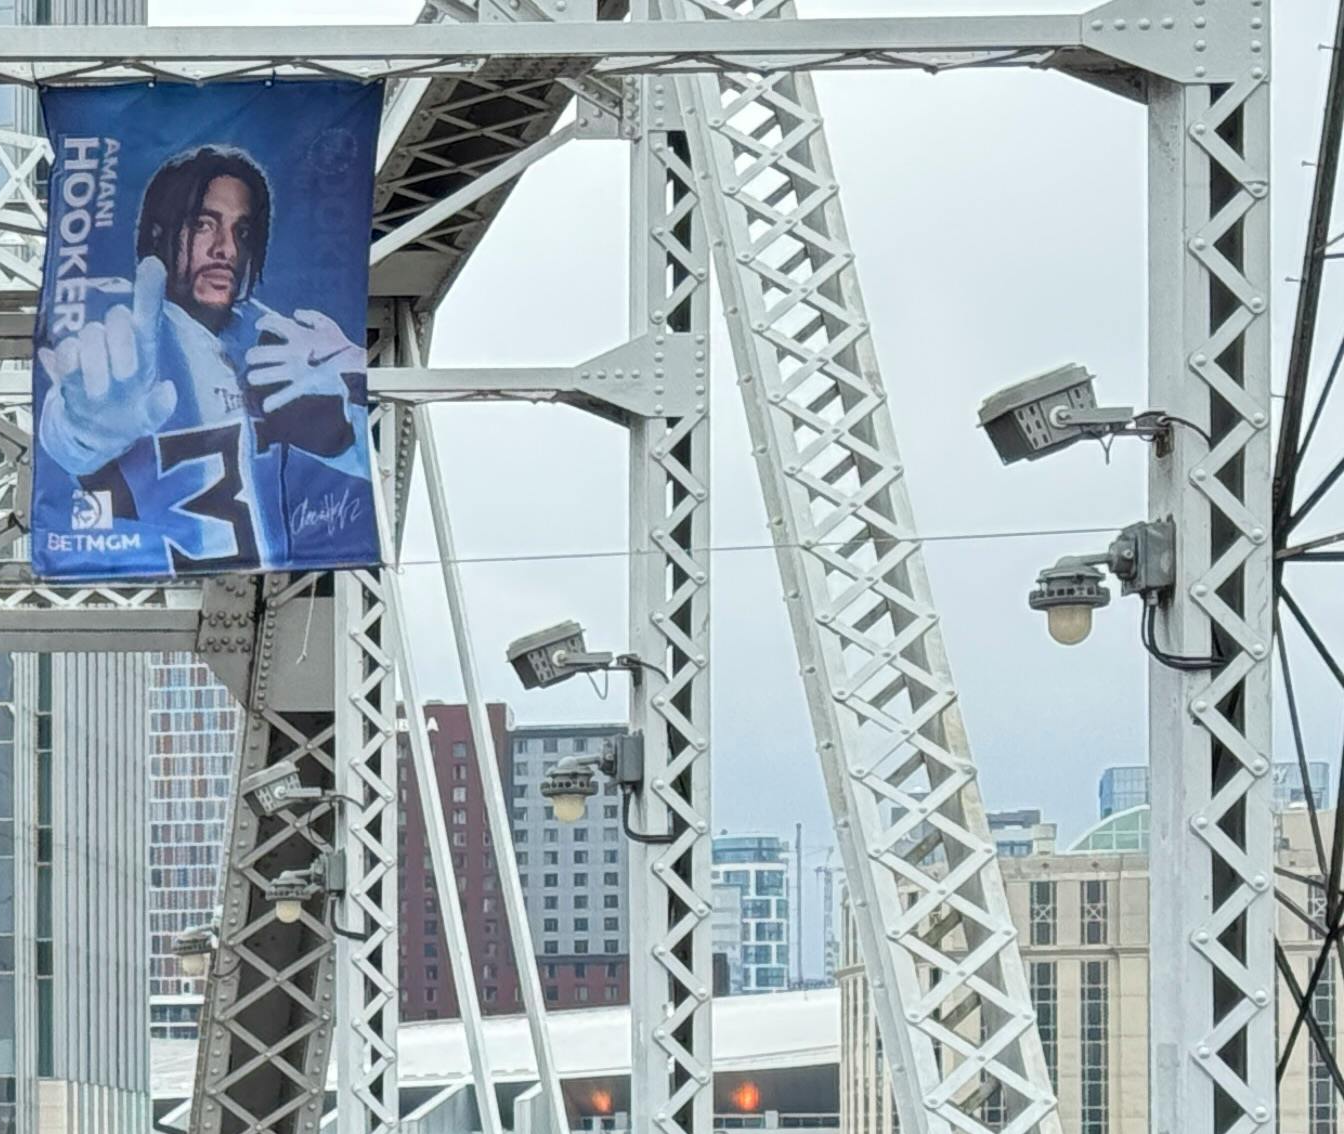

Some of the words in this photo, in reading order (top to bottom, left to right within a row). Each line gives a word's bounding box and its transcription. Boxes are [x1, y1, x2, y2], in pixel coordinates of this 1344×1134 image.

[95, 138, 121, 227] AMANI
[52, 138, 98, 334] HOOKER
[47, 532, 141, 552] BETMGM
